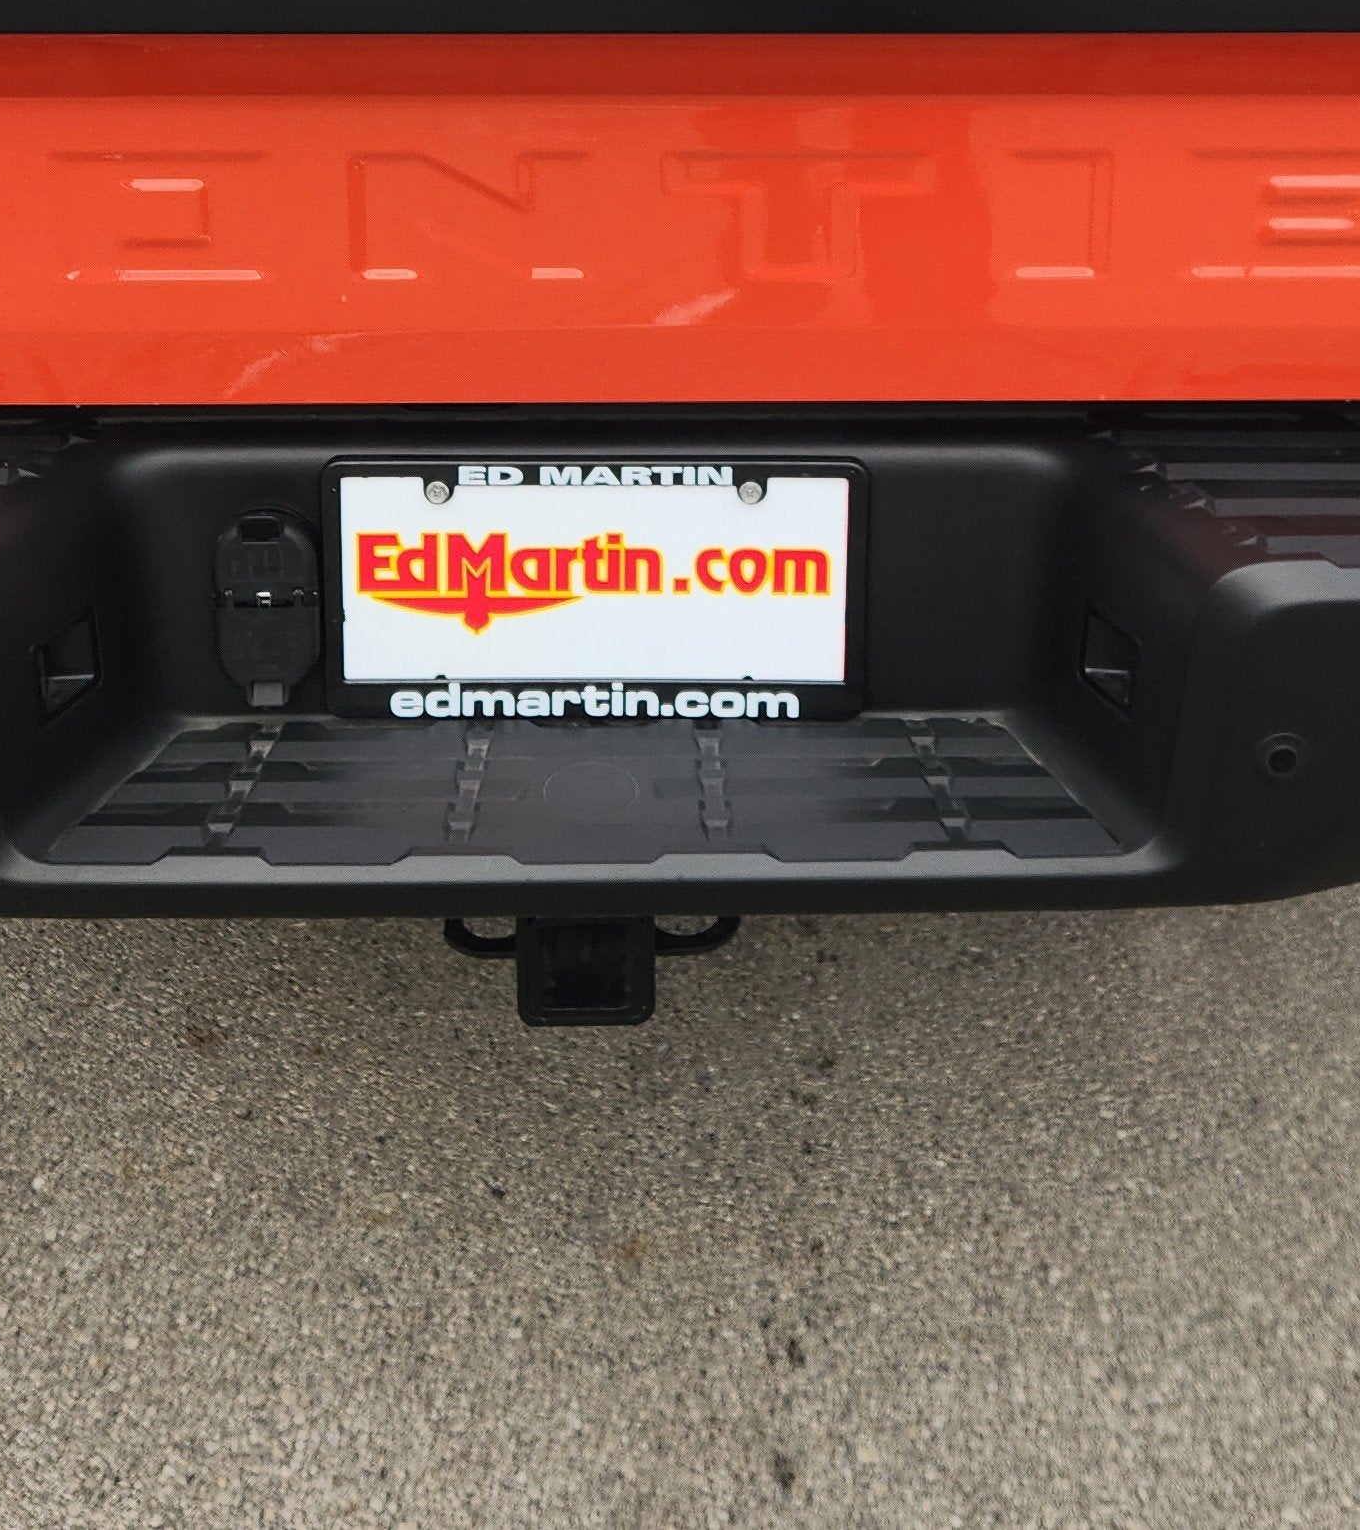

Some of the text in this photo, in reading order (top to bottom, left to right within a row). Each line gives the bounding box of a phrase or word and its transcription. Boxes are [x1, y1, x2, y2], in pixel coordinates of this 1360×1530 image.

[458, 466, 734, 486] ED MARTIN
[390, 683, 800, 719] edmartin.com
